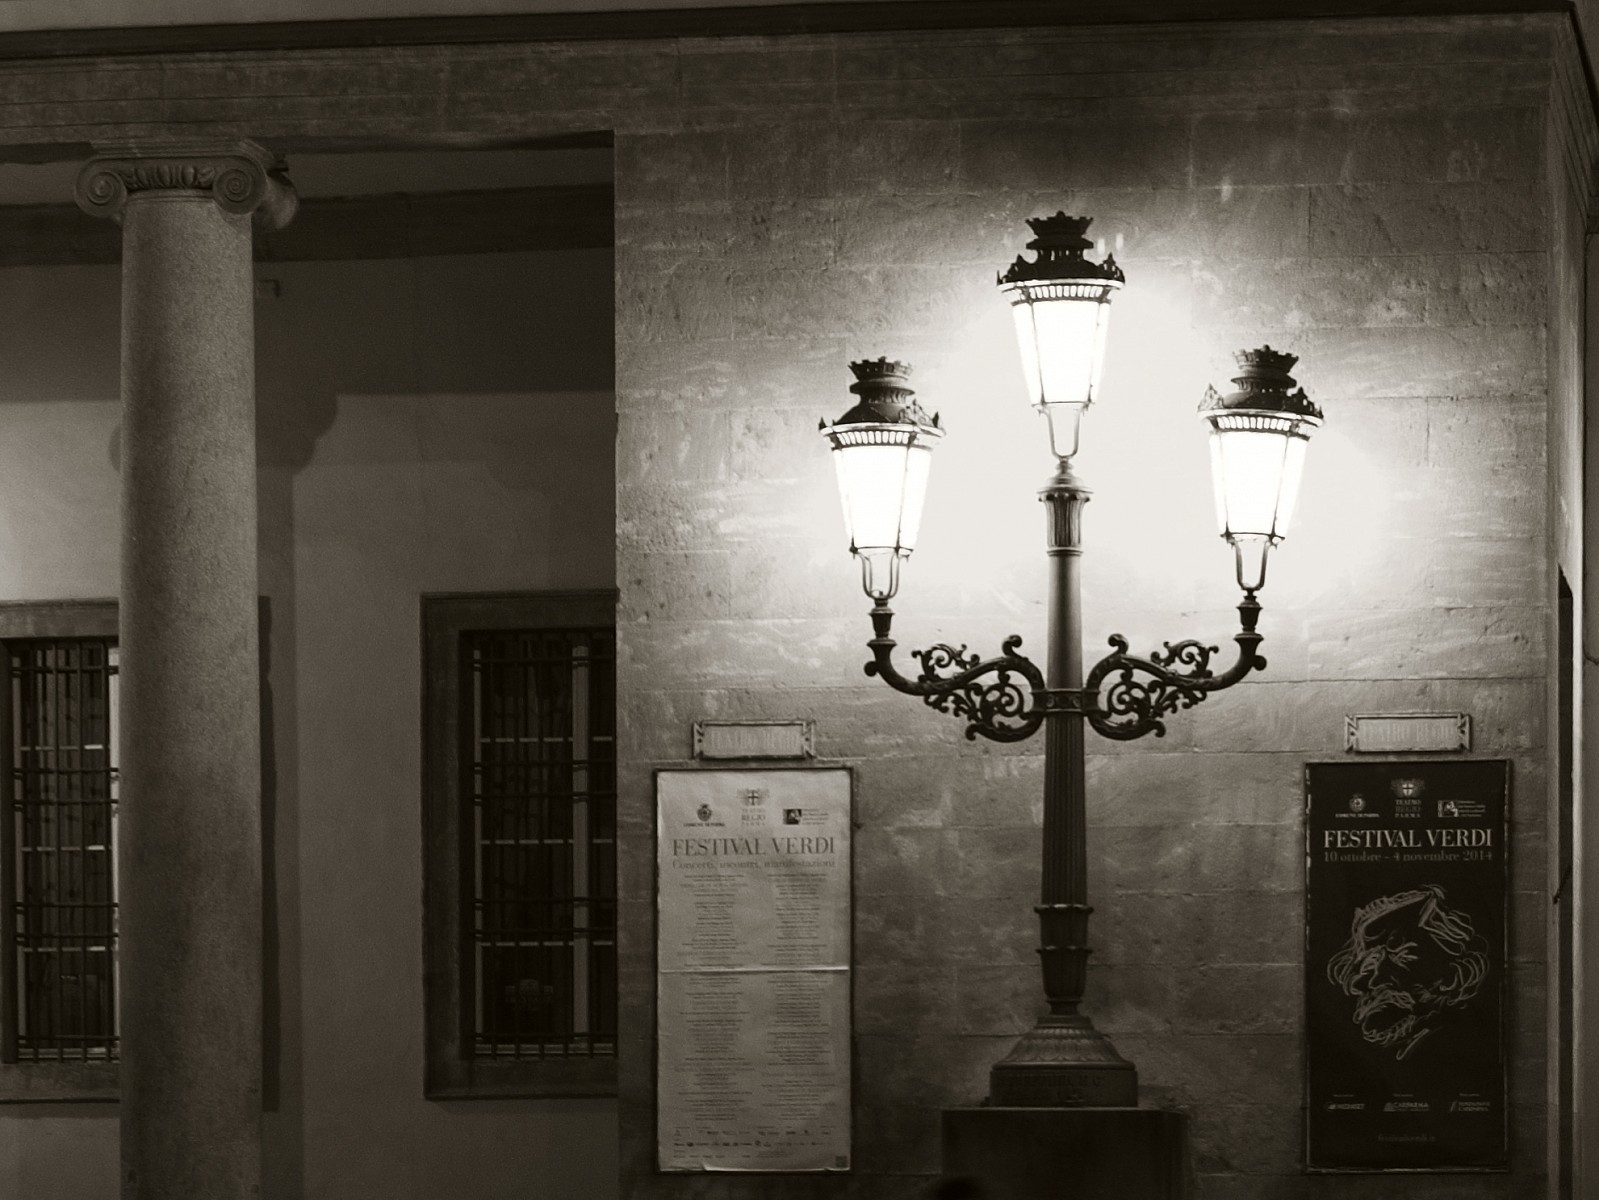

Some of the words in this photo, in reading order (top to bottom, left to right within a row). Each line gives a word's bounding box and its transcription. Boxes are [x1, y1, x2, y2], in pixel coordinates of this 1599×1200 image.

[672, 838, 767, 857] FESTIVAL
[771, 837, 834, 855] VERDI
[1324, 830, 1422, 848] FESTIVAL
[1425, 829, 1492, 847] VERDI
[1324, 850, 1338, 862] 10
[1340, 850, 1382, 862] ottobre
[1392, 850, 1400, 861] 4
[1402, 849, 1460, 862] novembre
[1463, 850, 1492, 861] 2014
